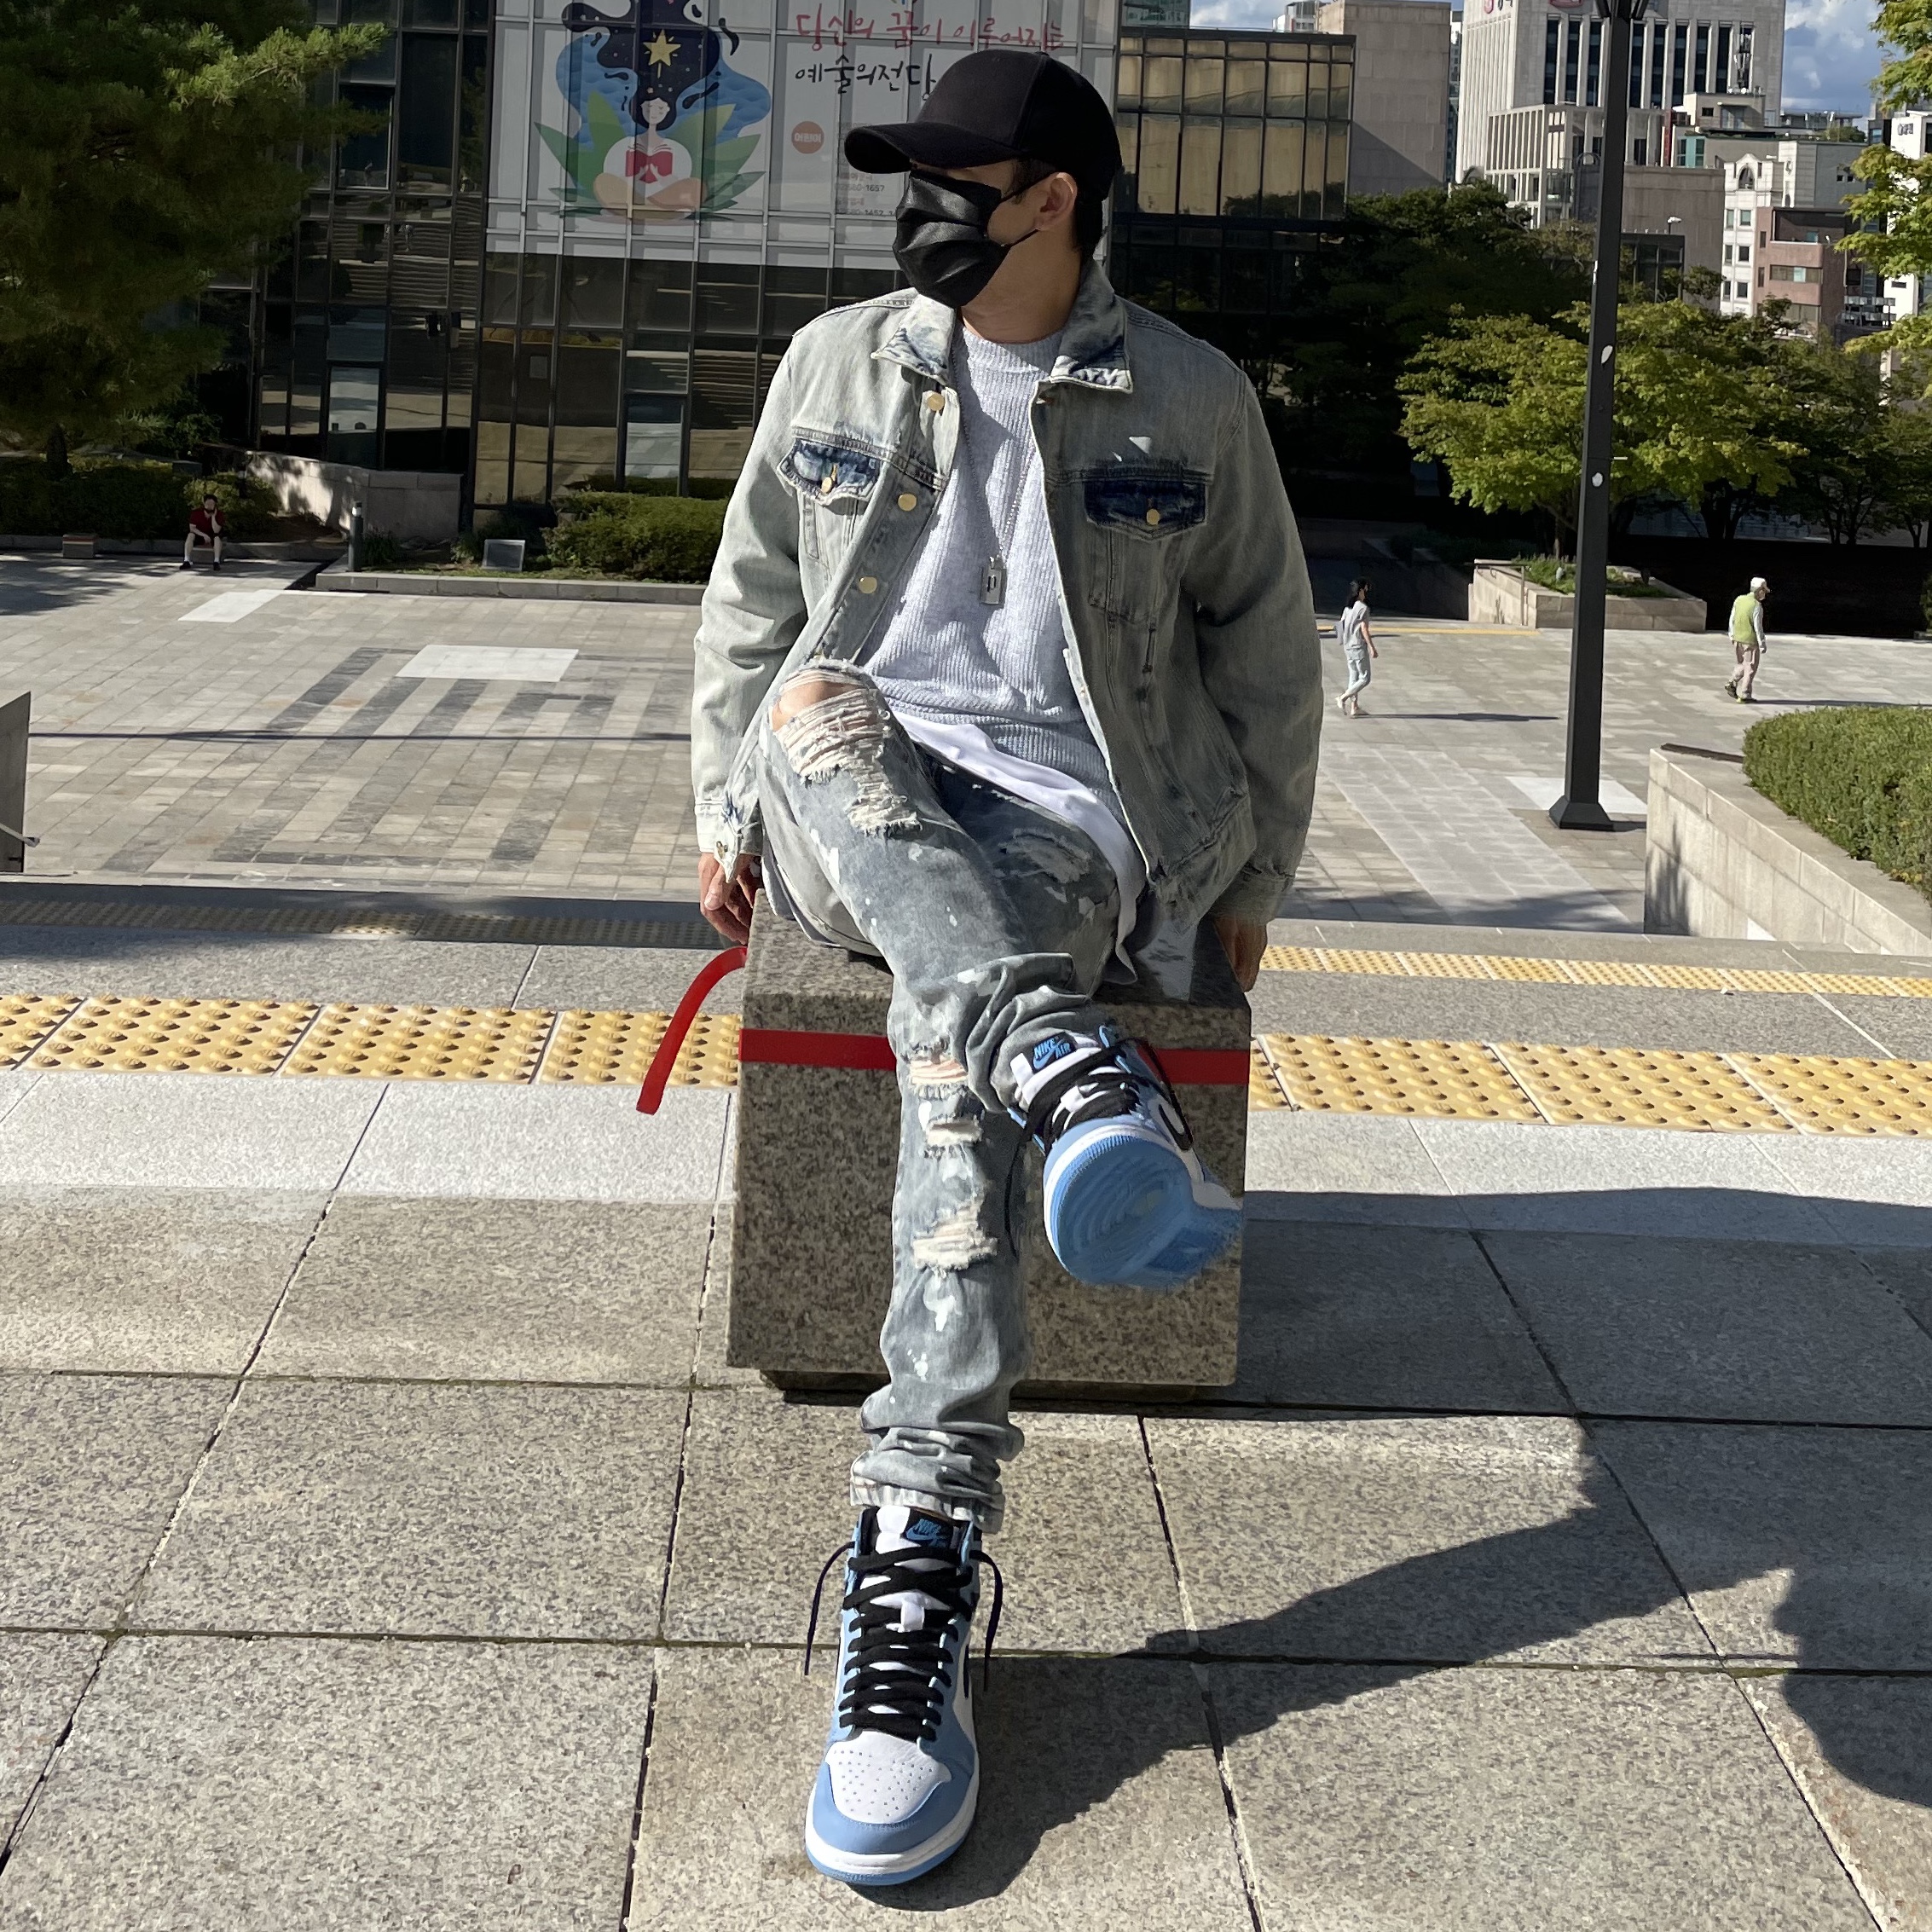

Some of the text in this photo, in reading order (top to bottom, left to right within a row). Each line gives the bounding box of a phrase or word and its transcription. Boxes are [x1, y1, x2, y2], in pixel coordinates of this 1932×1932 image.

[795, 3, 1065, 52] 당신의 꿈이 이루어지는
[795, 53, 937, 101] 예술의전당
[794, 132, 822, 143] 어린이
[1033, 1038, 1056, 1060] NIKE
[1055, 1042, 1072, 1060] AIR
